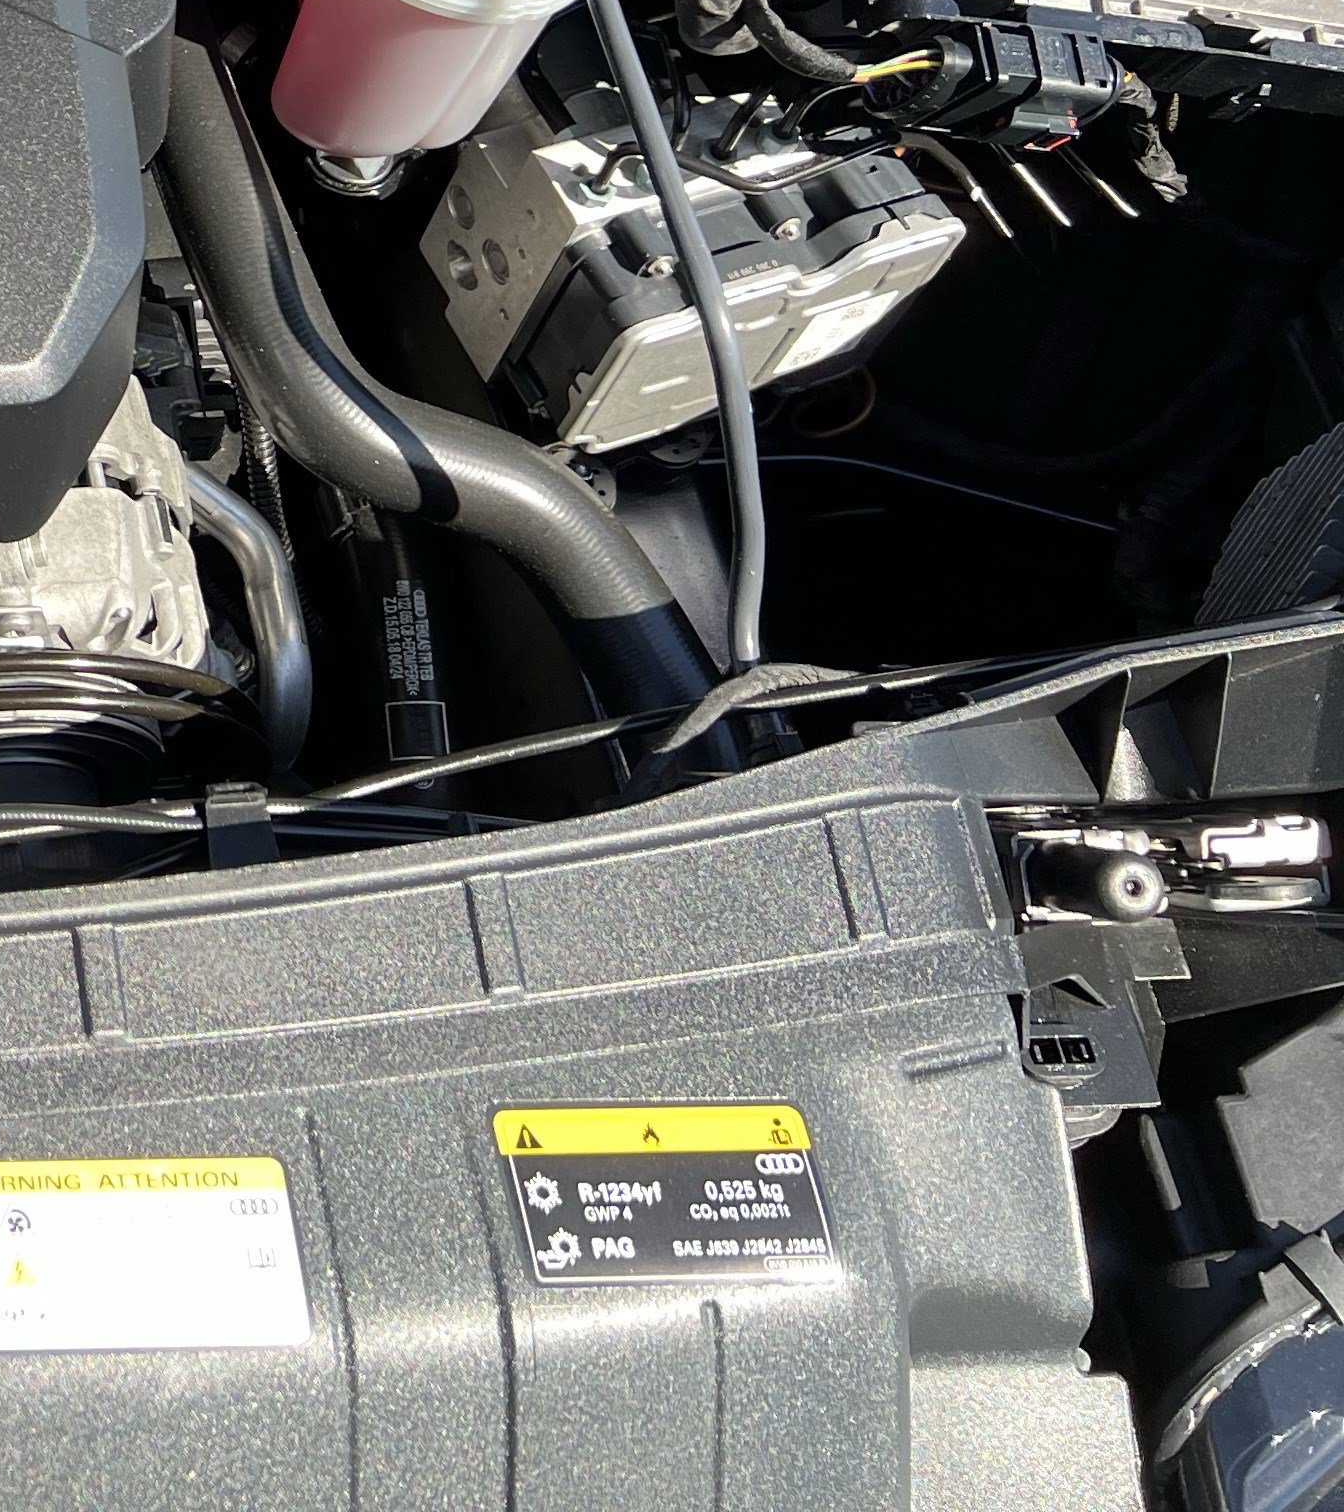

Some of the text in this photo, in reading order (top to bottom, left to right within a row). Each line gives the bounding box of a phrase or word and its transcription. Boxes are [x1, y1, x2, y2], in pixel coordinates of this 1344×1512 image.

[99, 1171, 239, 1189] ATTENTION
[577, 1180, 662, 1207] R-1234yf
[704, 1179, 785, 1203] 0,525 kg
[584, 1205, 634, 1222] GWP 4
[720, 1206, 740, 1222] eq
[591, 1236, 636, 1260] PAG
[672, 1239, 703, 1257] SAE
